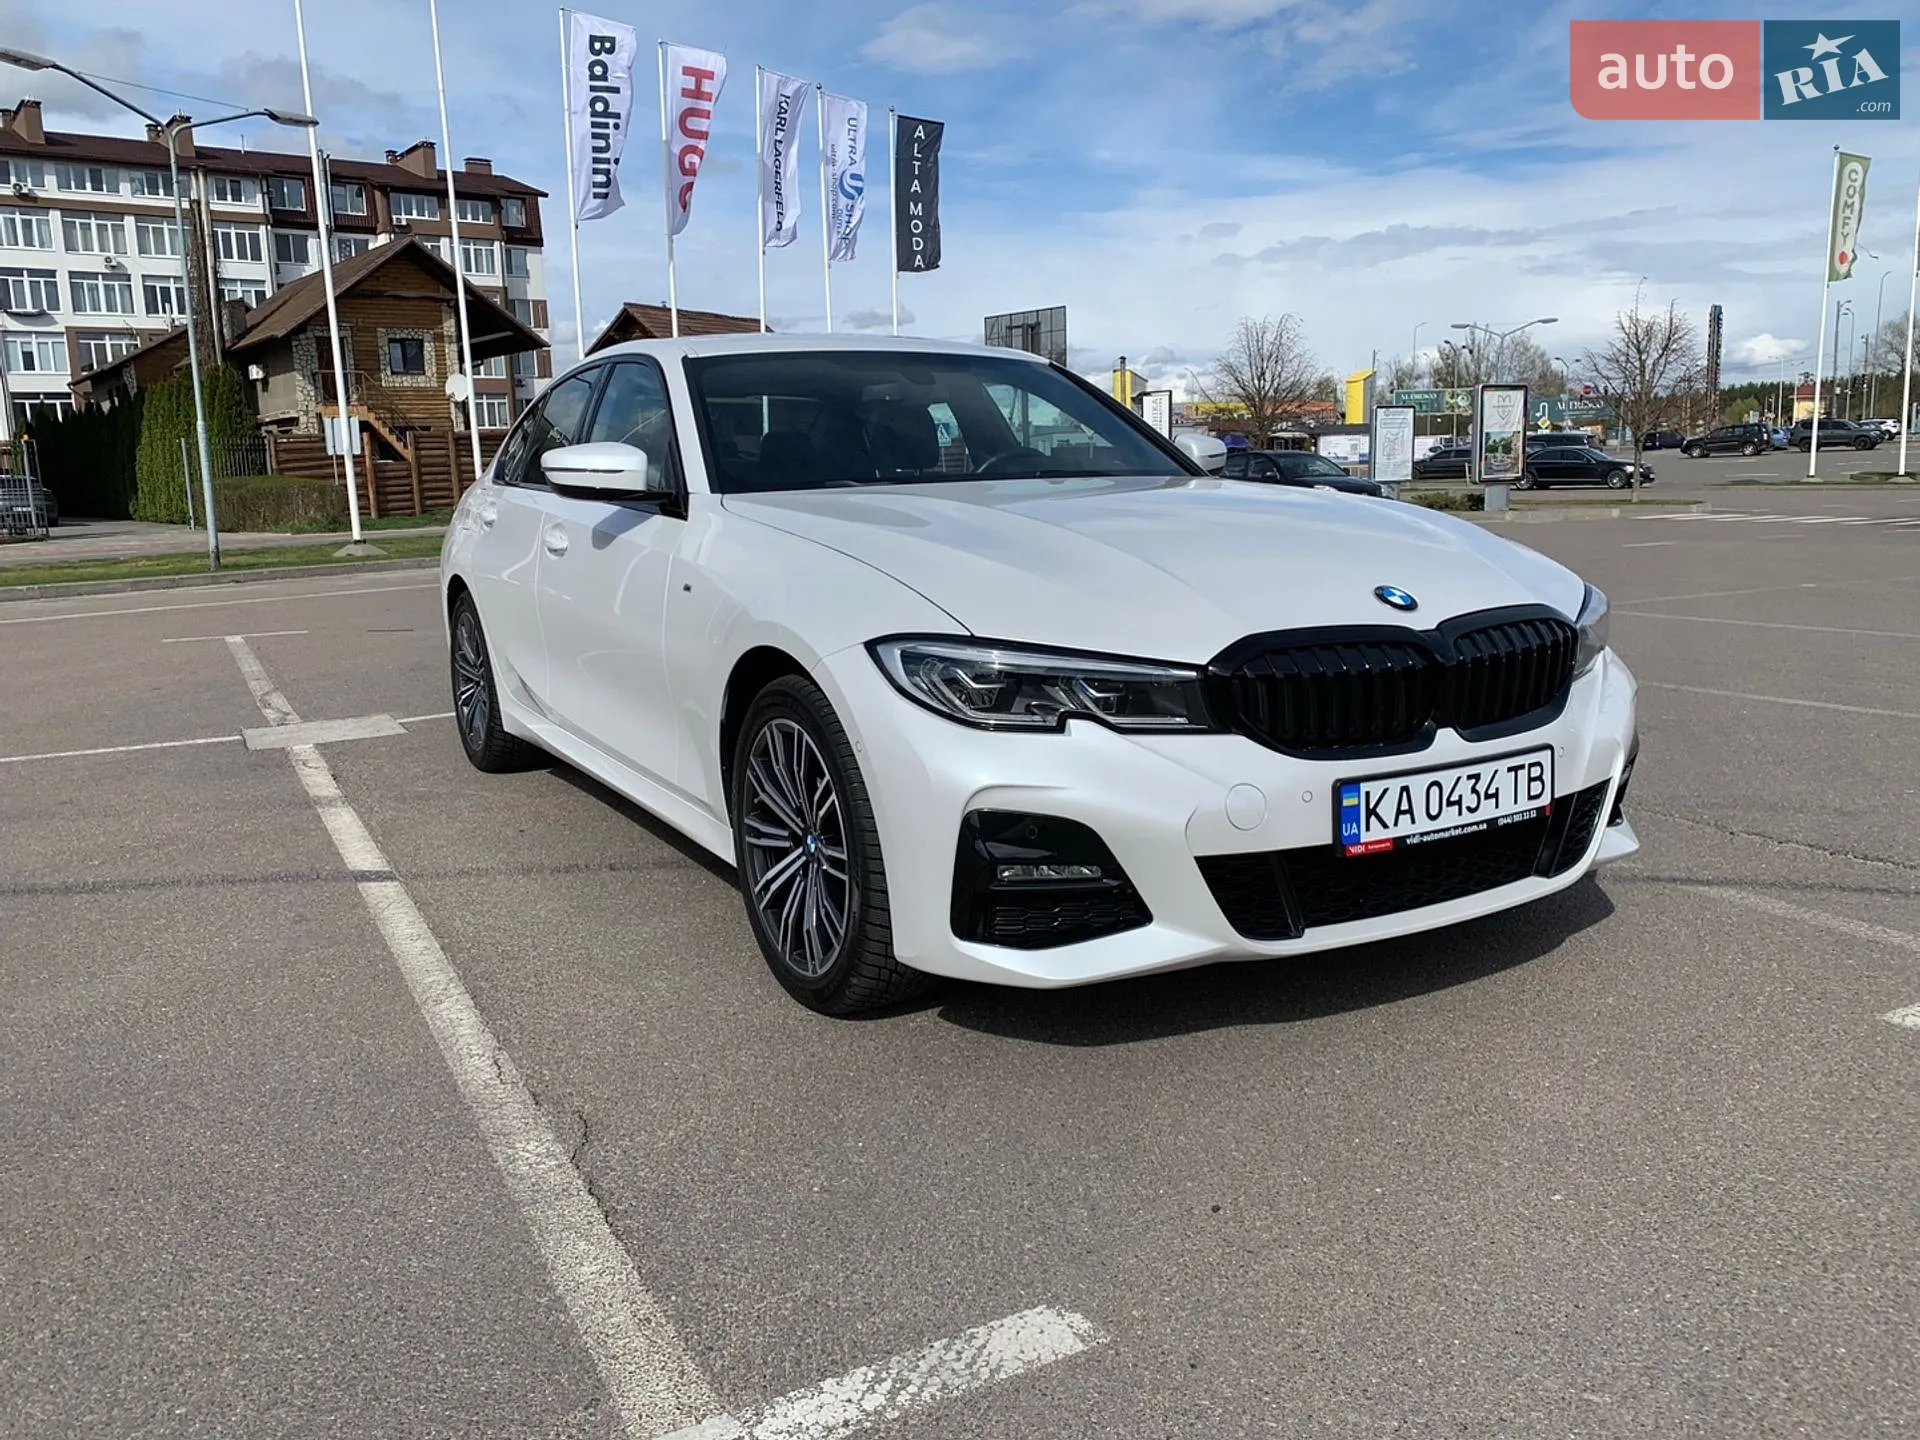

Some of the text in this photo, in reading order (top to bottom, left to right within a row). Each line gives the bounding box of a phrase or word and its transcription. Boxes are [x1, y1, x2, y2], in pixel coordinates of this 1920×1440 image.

[588, 34, 621, 200] Baldinini
[774, 93, 791, 137] KARL
[847, 117, 858, 167] ULTRA
[909, 124, 926, 269] ALTA MODA
[1841, 168, 1859, 246] COMFY
[1342, 822, 1359, 836] UA
[1365, 760, 1546, 832] KA 0434 TB
